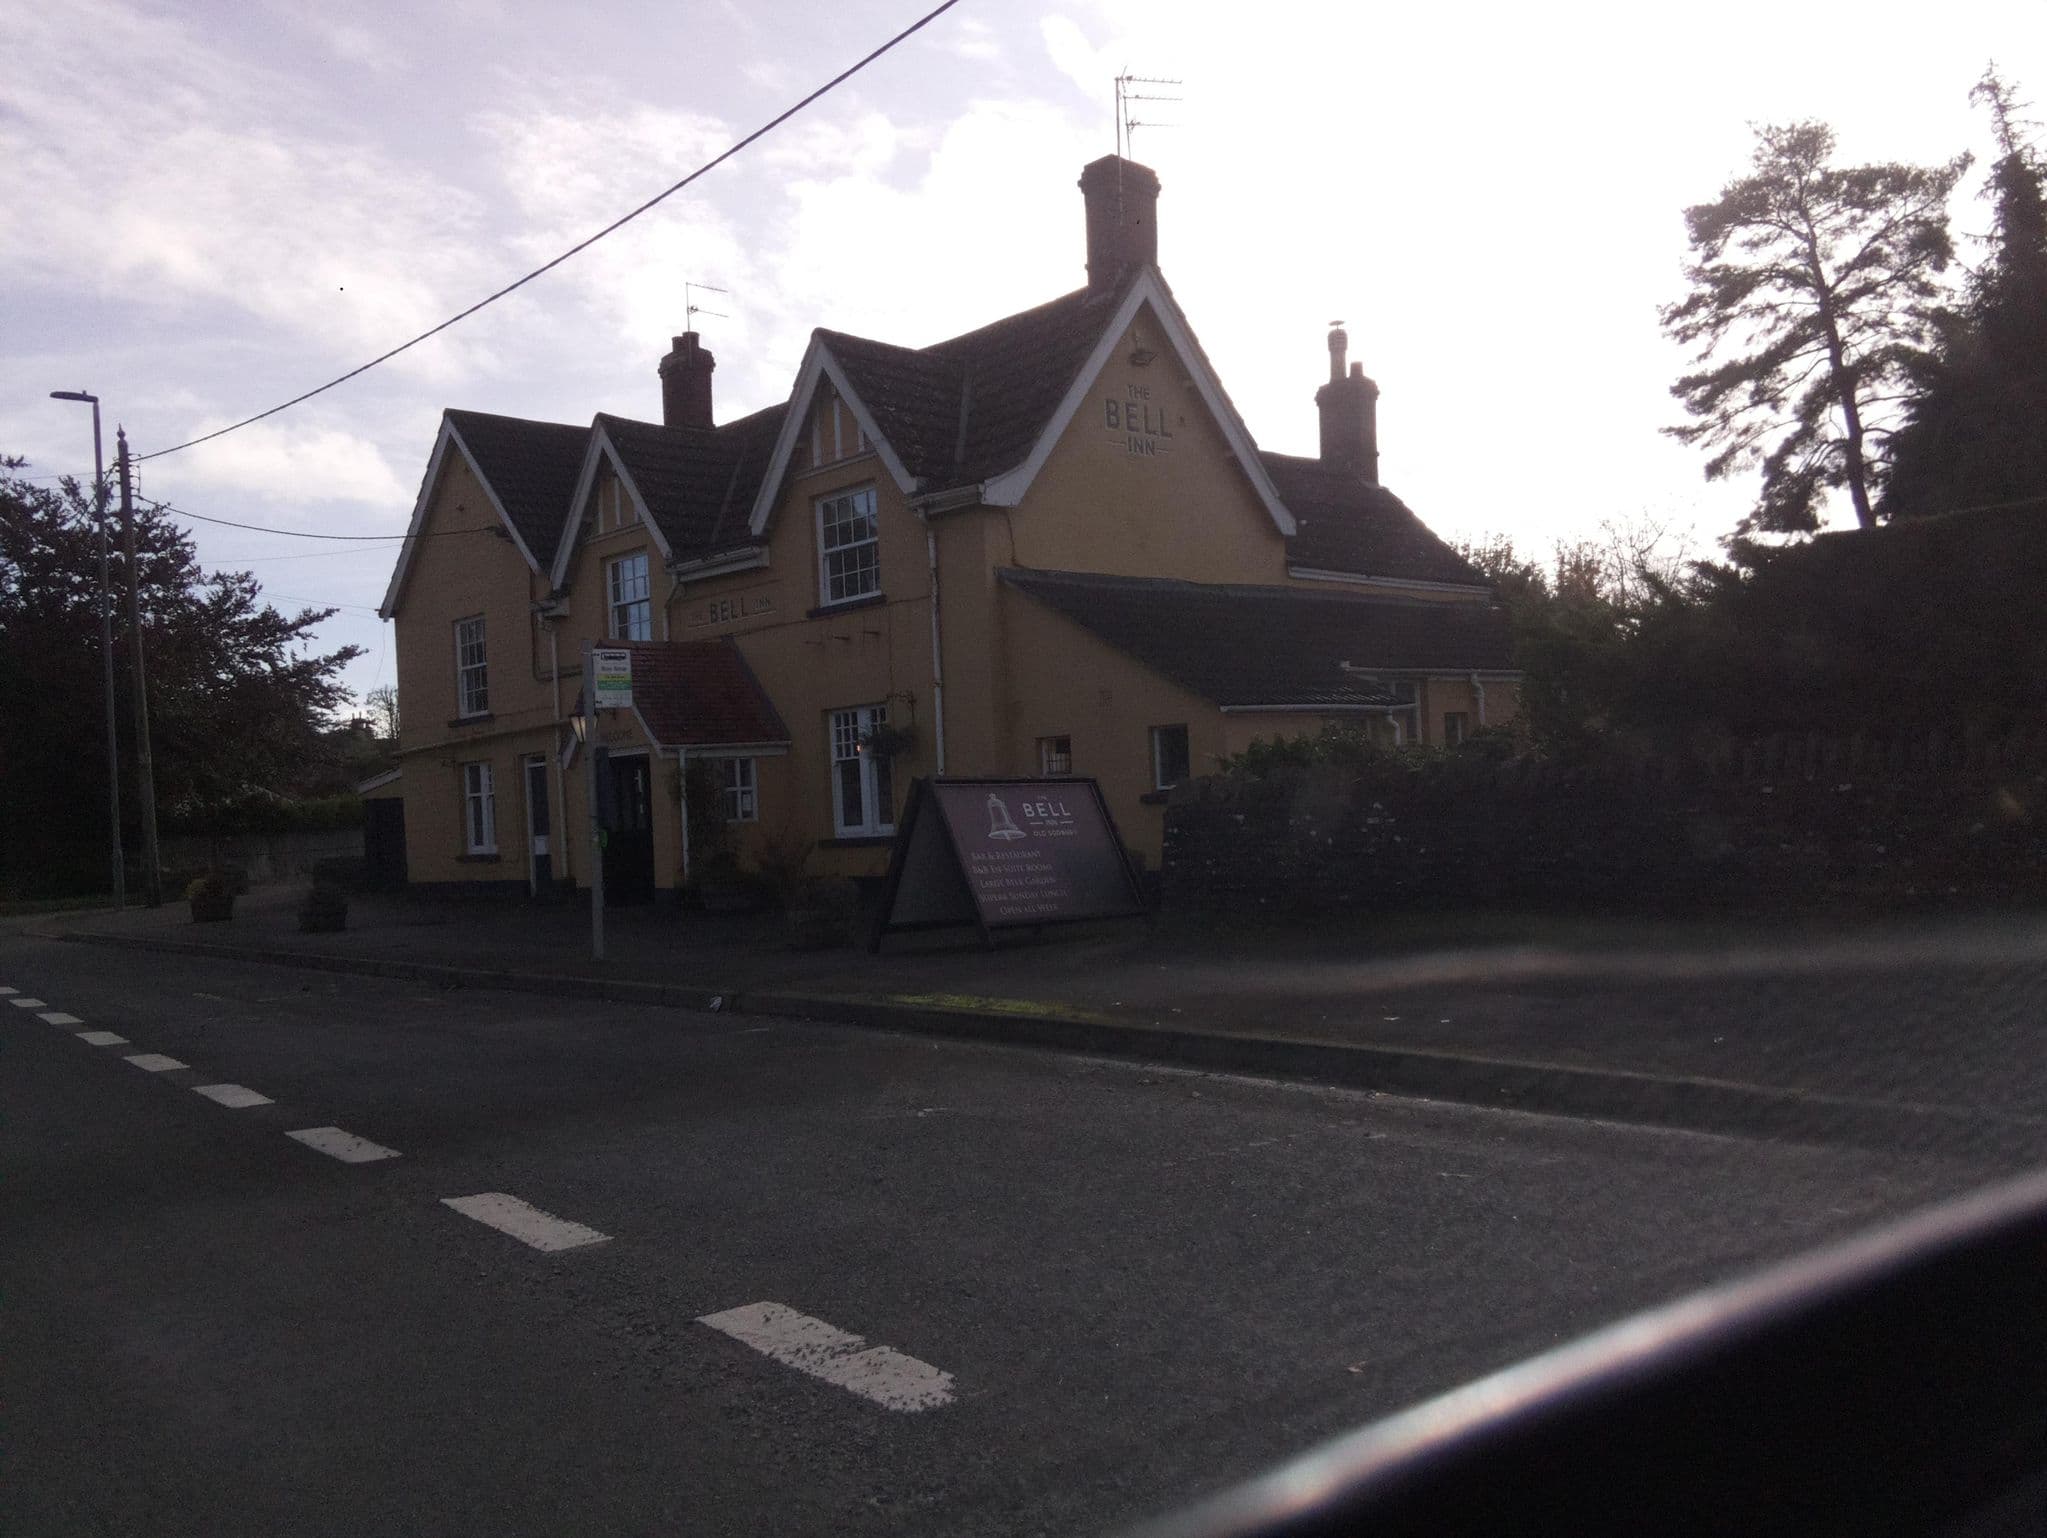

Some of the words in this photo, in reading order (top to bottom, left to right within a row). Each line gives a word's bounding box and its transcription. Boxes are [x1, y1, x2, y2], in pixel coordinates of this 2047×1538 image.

[1128, 384, 1151, 400] THE
[1105, 399, 1173, 438] BELL
[1128, 436, 1155, 456] INN
[710, 597, 748, 624] BELL
[1022, 802, 1071, 817] BELL
